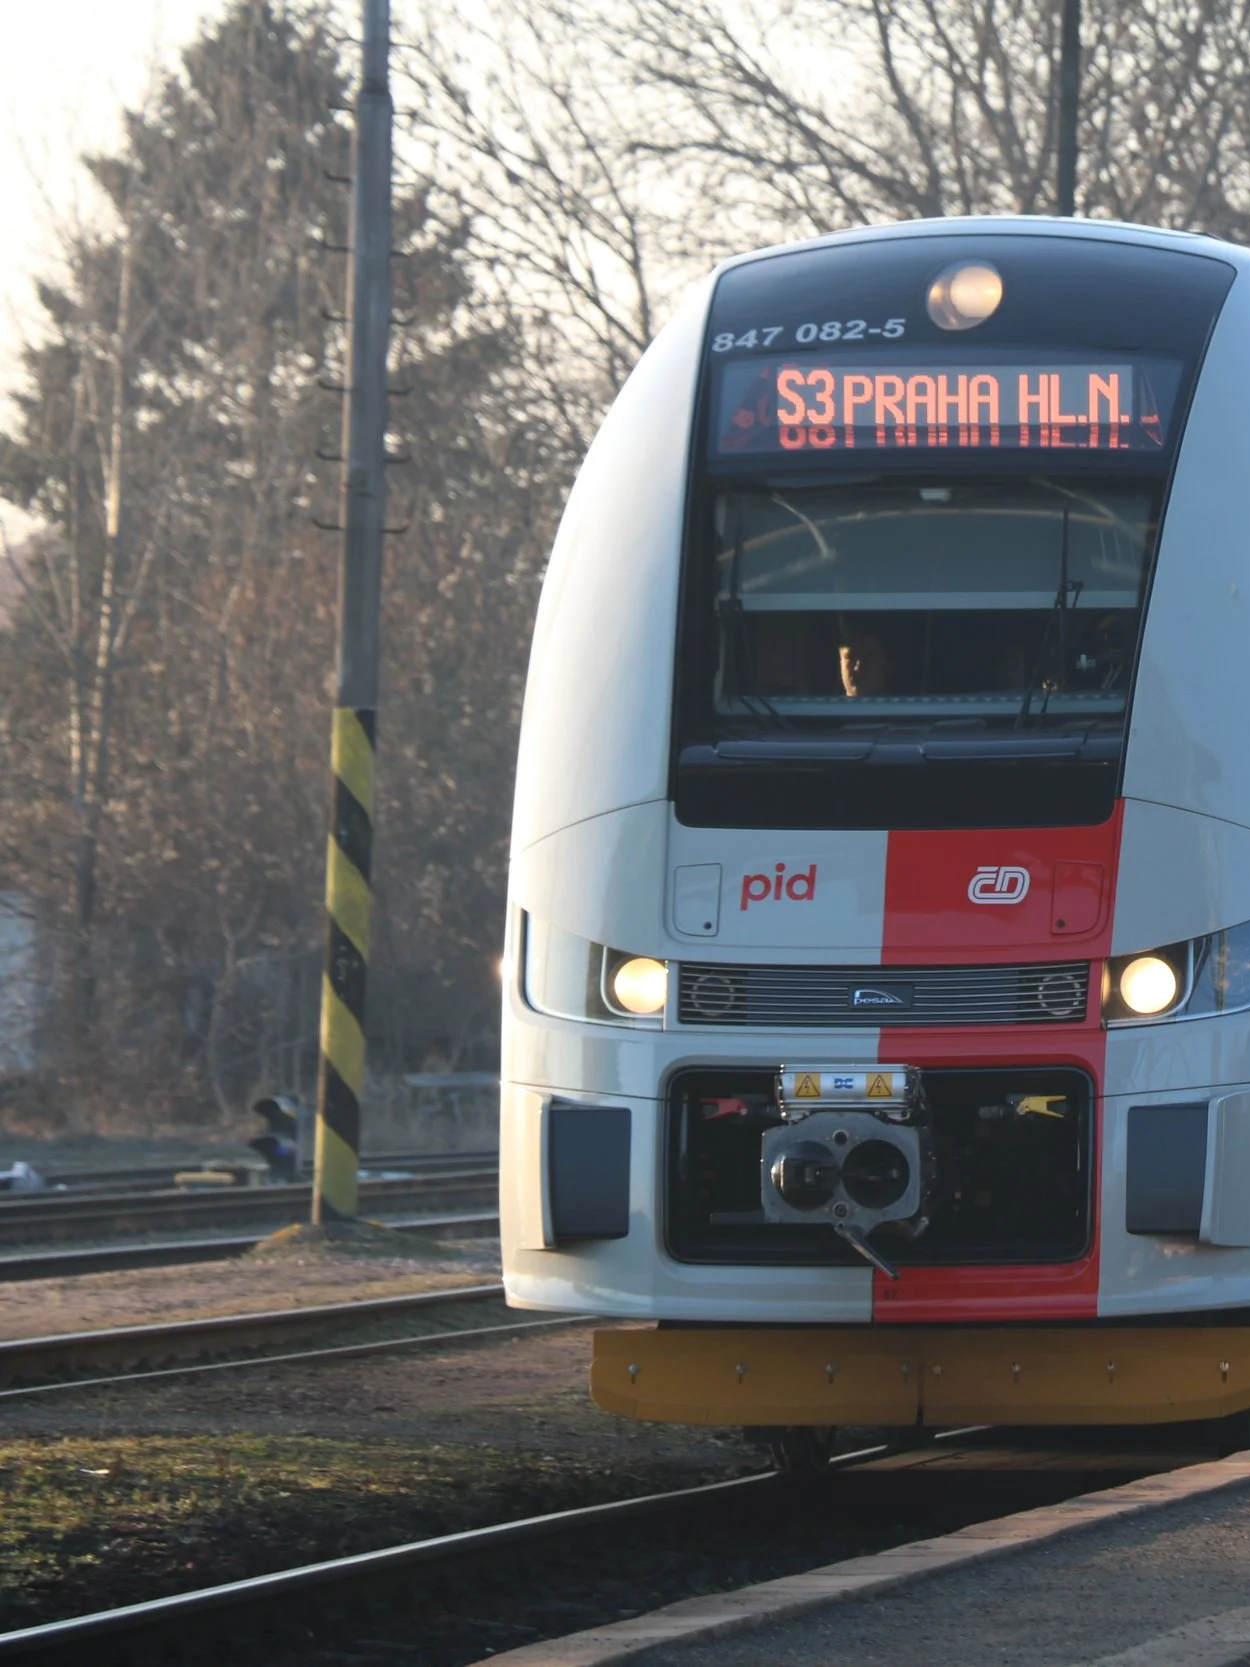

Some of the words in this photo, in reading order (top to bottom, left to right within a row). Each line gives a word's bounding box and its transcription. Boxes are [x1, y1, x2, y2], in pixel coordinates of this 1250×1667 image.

[712, 326, 784, 353] 847
[795, 318, 906, 344] 082-5
[776, 369, 836, 425] S3
[843, 373, 999, 425] PRAHA
[1018, 373, 1131, 425] HL.N.
[740, 862, 818, 911] pid
